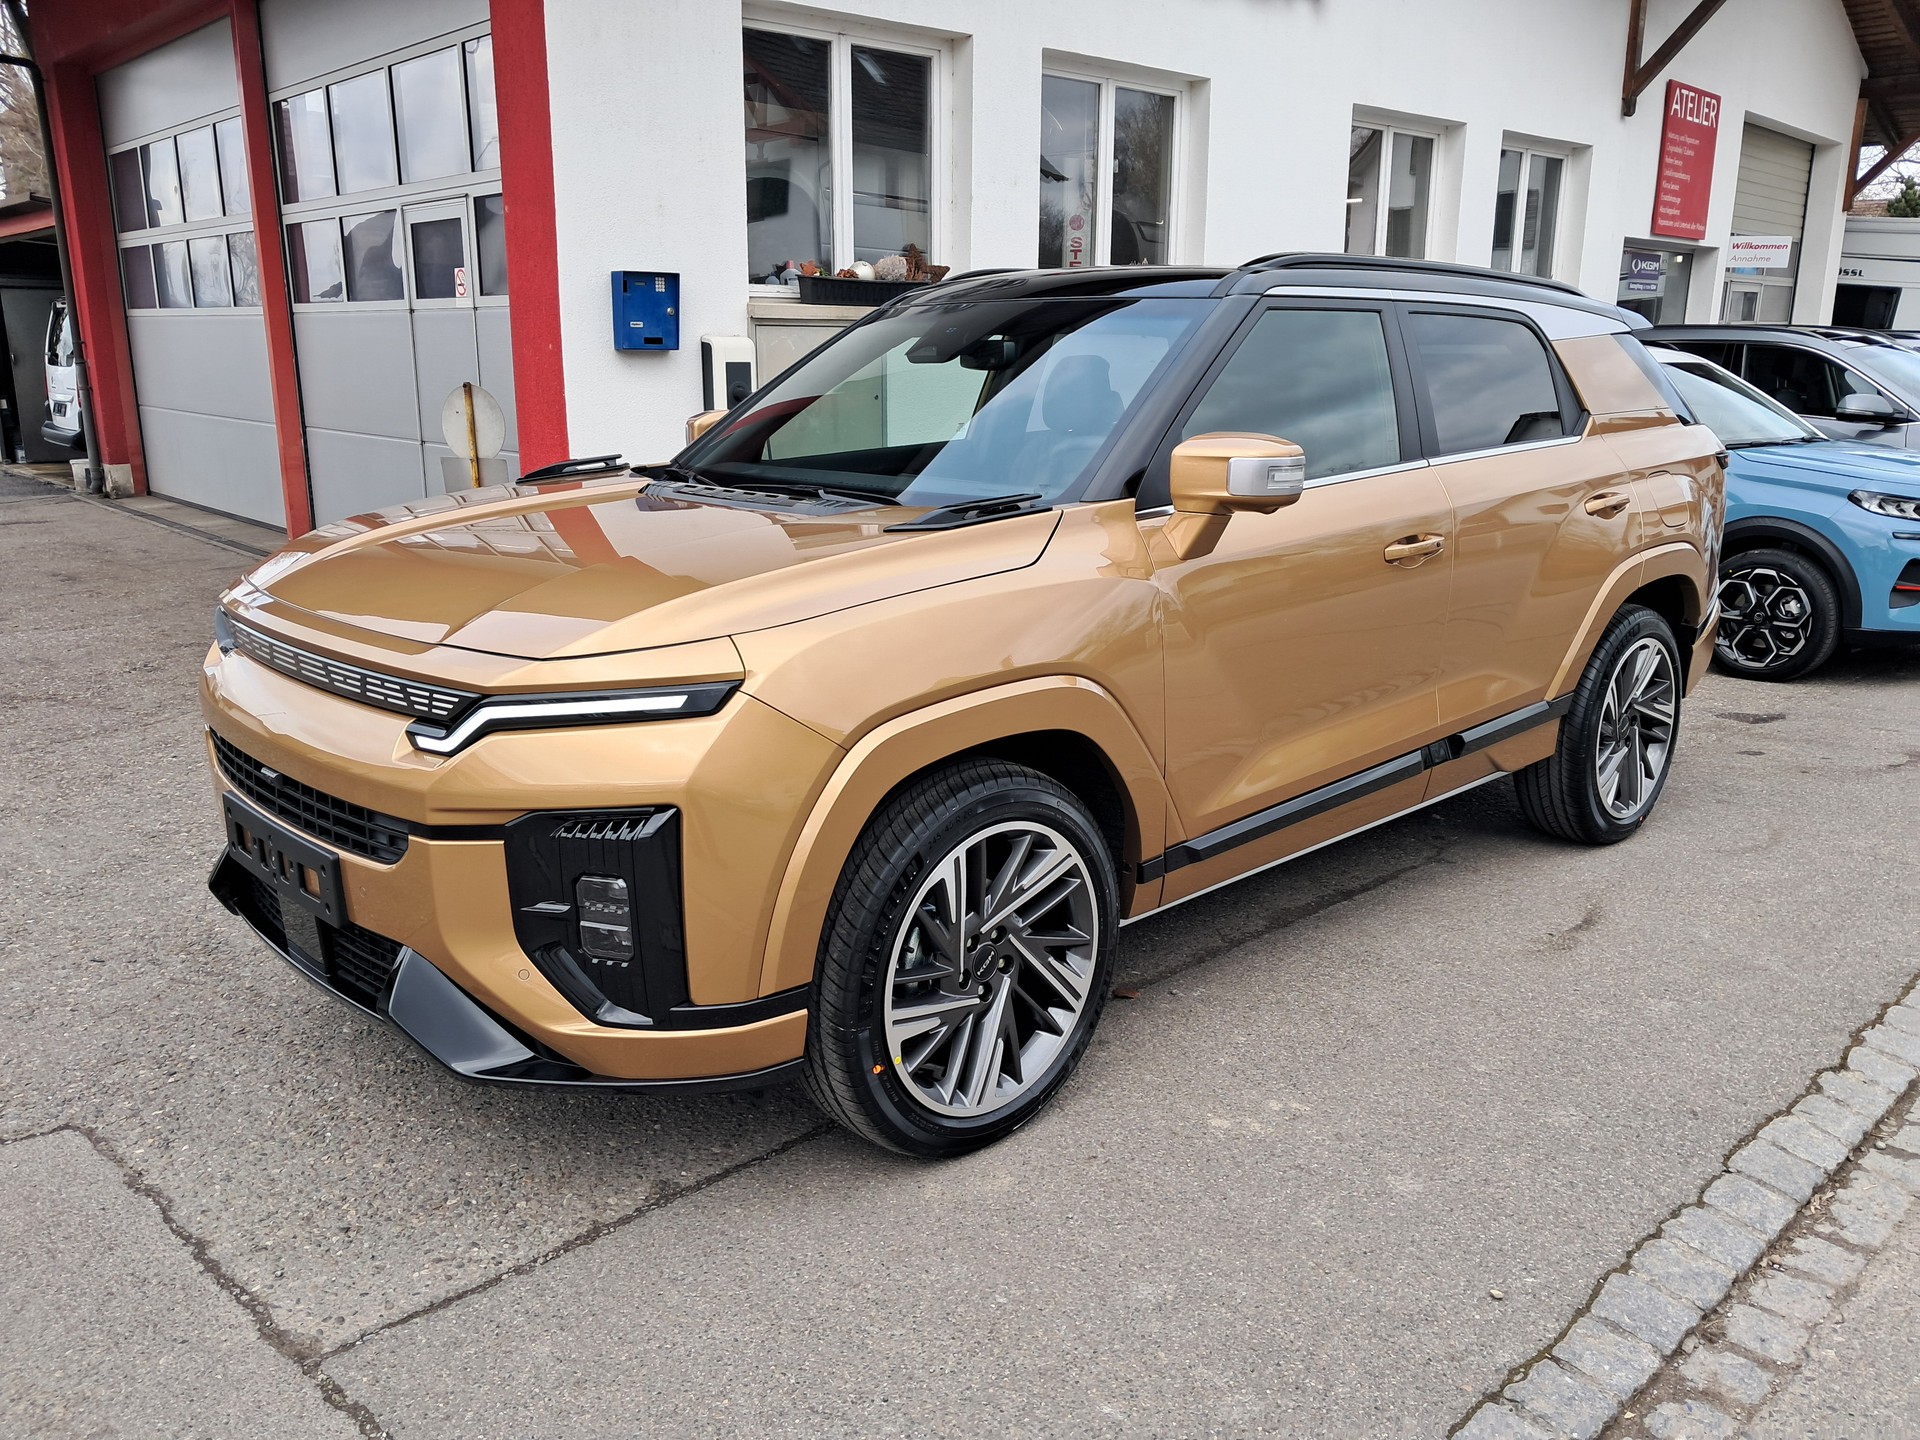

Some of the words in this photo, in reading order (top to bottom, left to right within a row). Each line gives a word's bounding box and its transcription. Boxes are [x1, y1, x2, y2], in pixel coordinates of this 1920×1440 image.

[1670, 87, 1718, 129] ATELIER
[1732, 242, 1788, 250] Willkommen
[1730, 254, 1771, 262] Annahme
[1641, 261, 1660, 271] KGM
[977, 951, 995, 976] KGM
